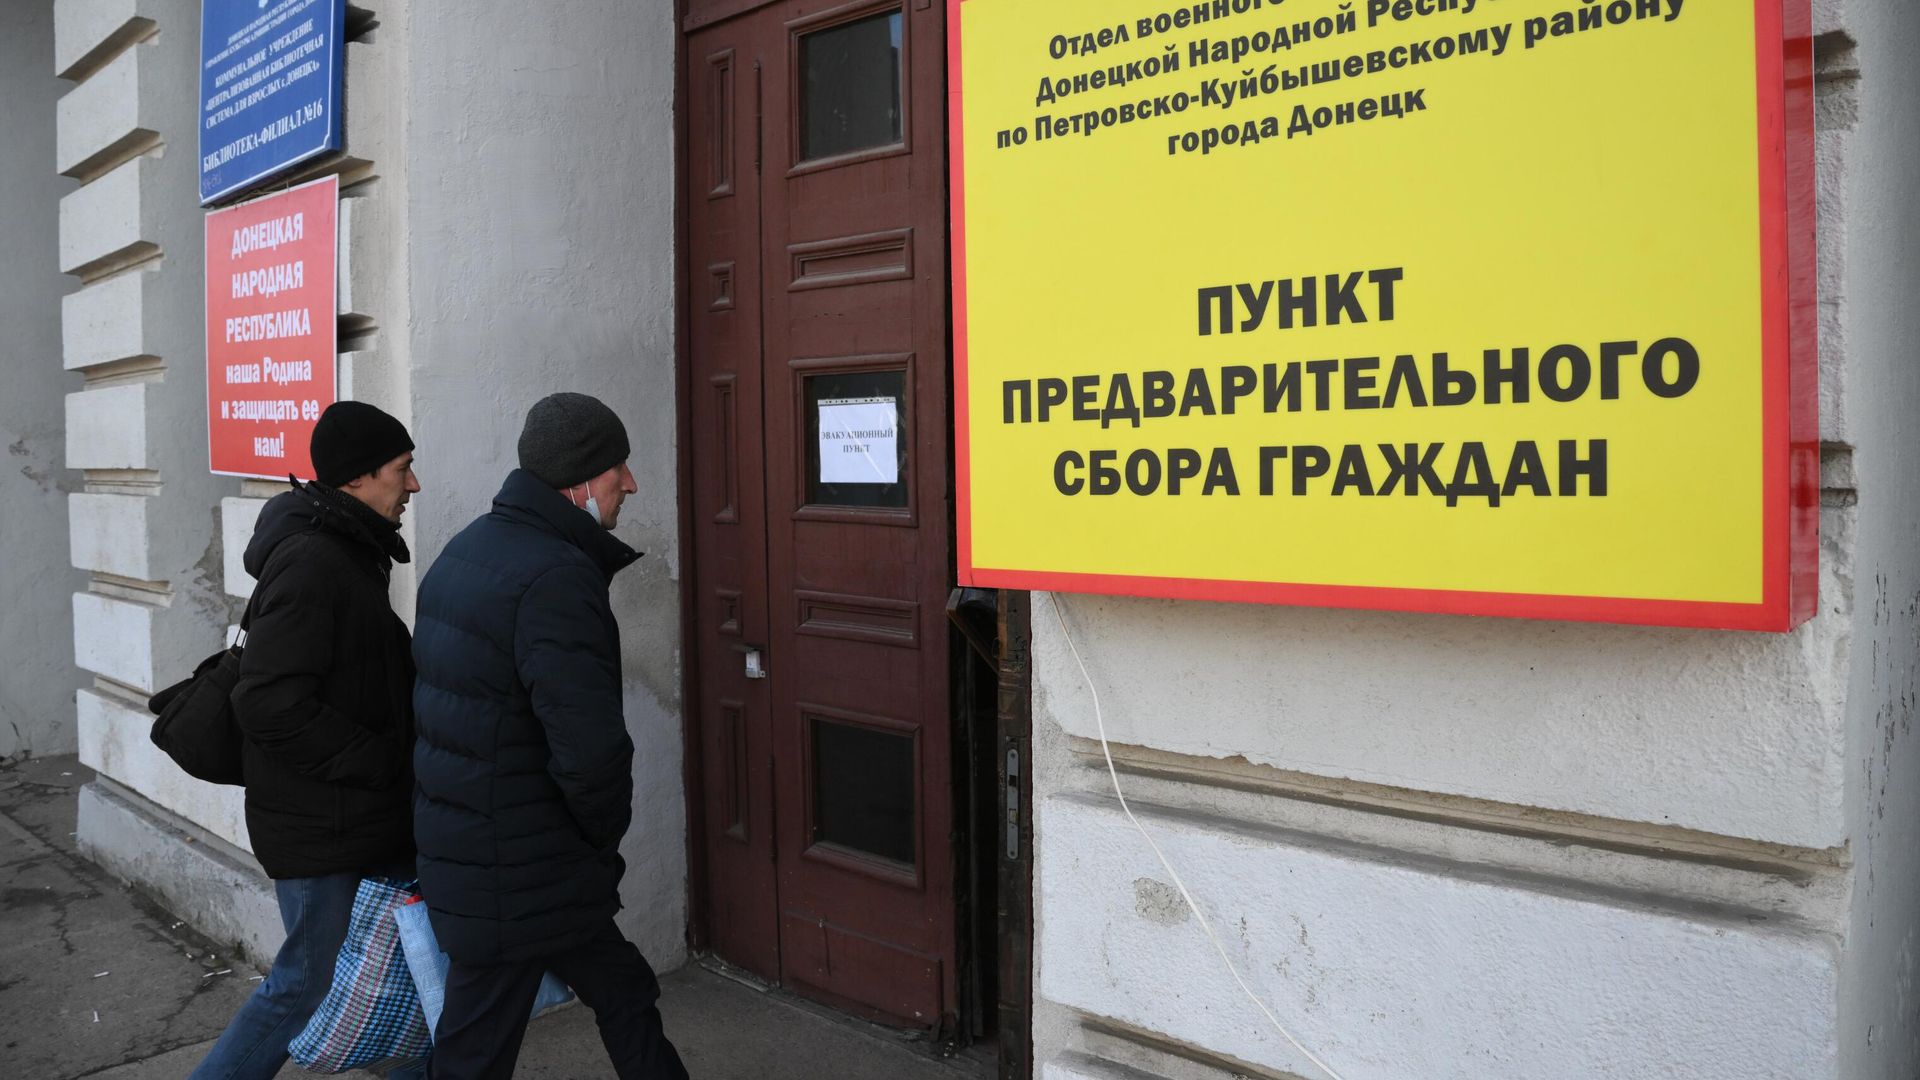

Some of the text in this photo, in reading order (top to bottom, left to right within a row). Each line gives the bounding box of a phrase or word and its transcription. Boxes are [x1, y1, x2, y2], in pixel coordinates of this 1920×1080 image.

[215, 18, 313, 88] КОММУНАЛЬНОЕ УЧРЕЖДЕНИЕ
[271, 33, 323, 75] БИБЛИОТЕЧНАЯ
[1035, 43, 1180, 107] Донецкой
[1189, 2, 1356, 68] Народной
[1049, 0, 1283, 60] Отдел военно
[997, 0, 1685, 149] по Петровско-Куйбышевскому району
[206, 105, 233, 129] СИСТЕМА
[234, 98, 247, 117] ДЛЯ
[248, 78, 281, 107] ВЗРОСЛЫХ
[1169, 89, 1427, 155] города Донецк
[203, 97, 323, 173] БИБЛИОТЕКА-ФИЛИАЛ №16
[231, 212, 304, 260] ДОНЕЦКАЯ
[232, 260, 304, 299] НАРОДНАЯ
[1198, 268, 1404, 336] ПУНКТ
[226, 308, 311, 343] РЕСПУБЛИКА
[226, 357, 312, 386] наша Родина
[1003, 338, 1700, 429] ПРЕДВАРИТЕЛЬНОГО
[222, 399, 319, 422] и защищать ее
[821, 427, 894, 440] ЭВАКУАЦИОННЫЙ
[254, 431, 285, 458] нам!
[1054, 439, 1608, 508] СБОРА ГРАЖДАН
